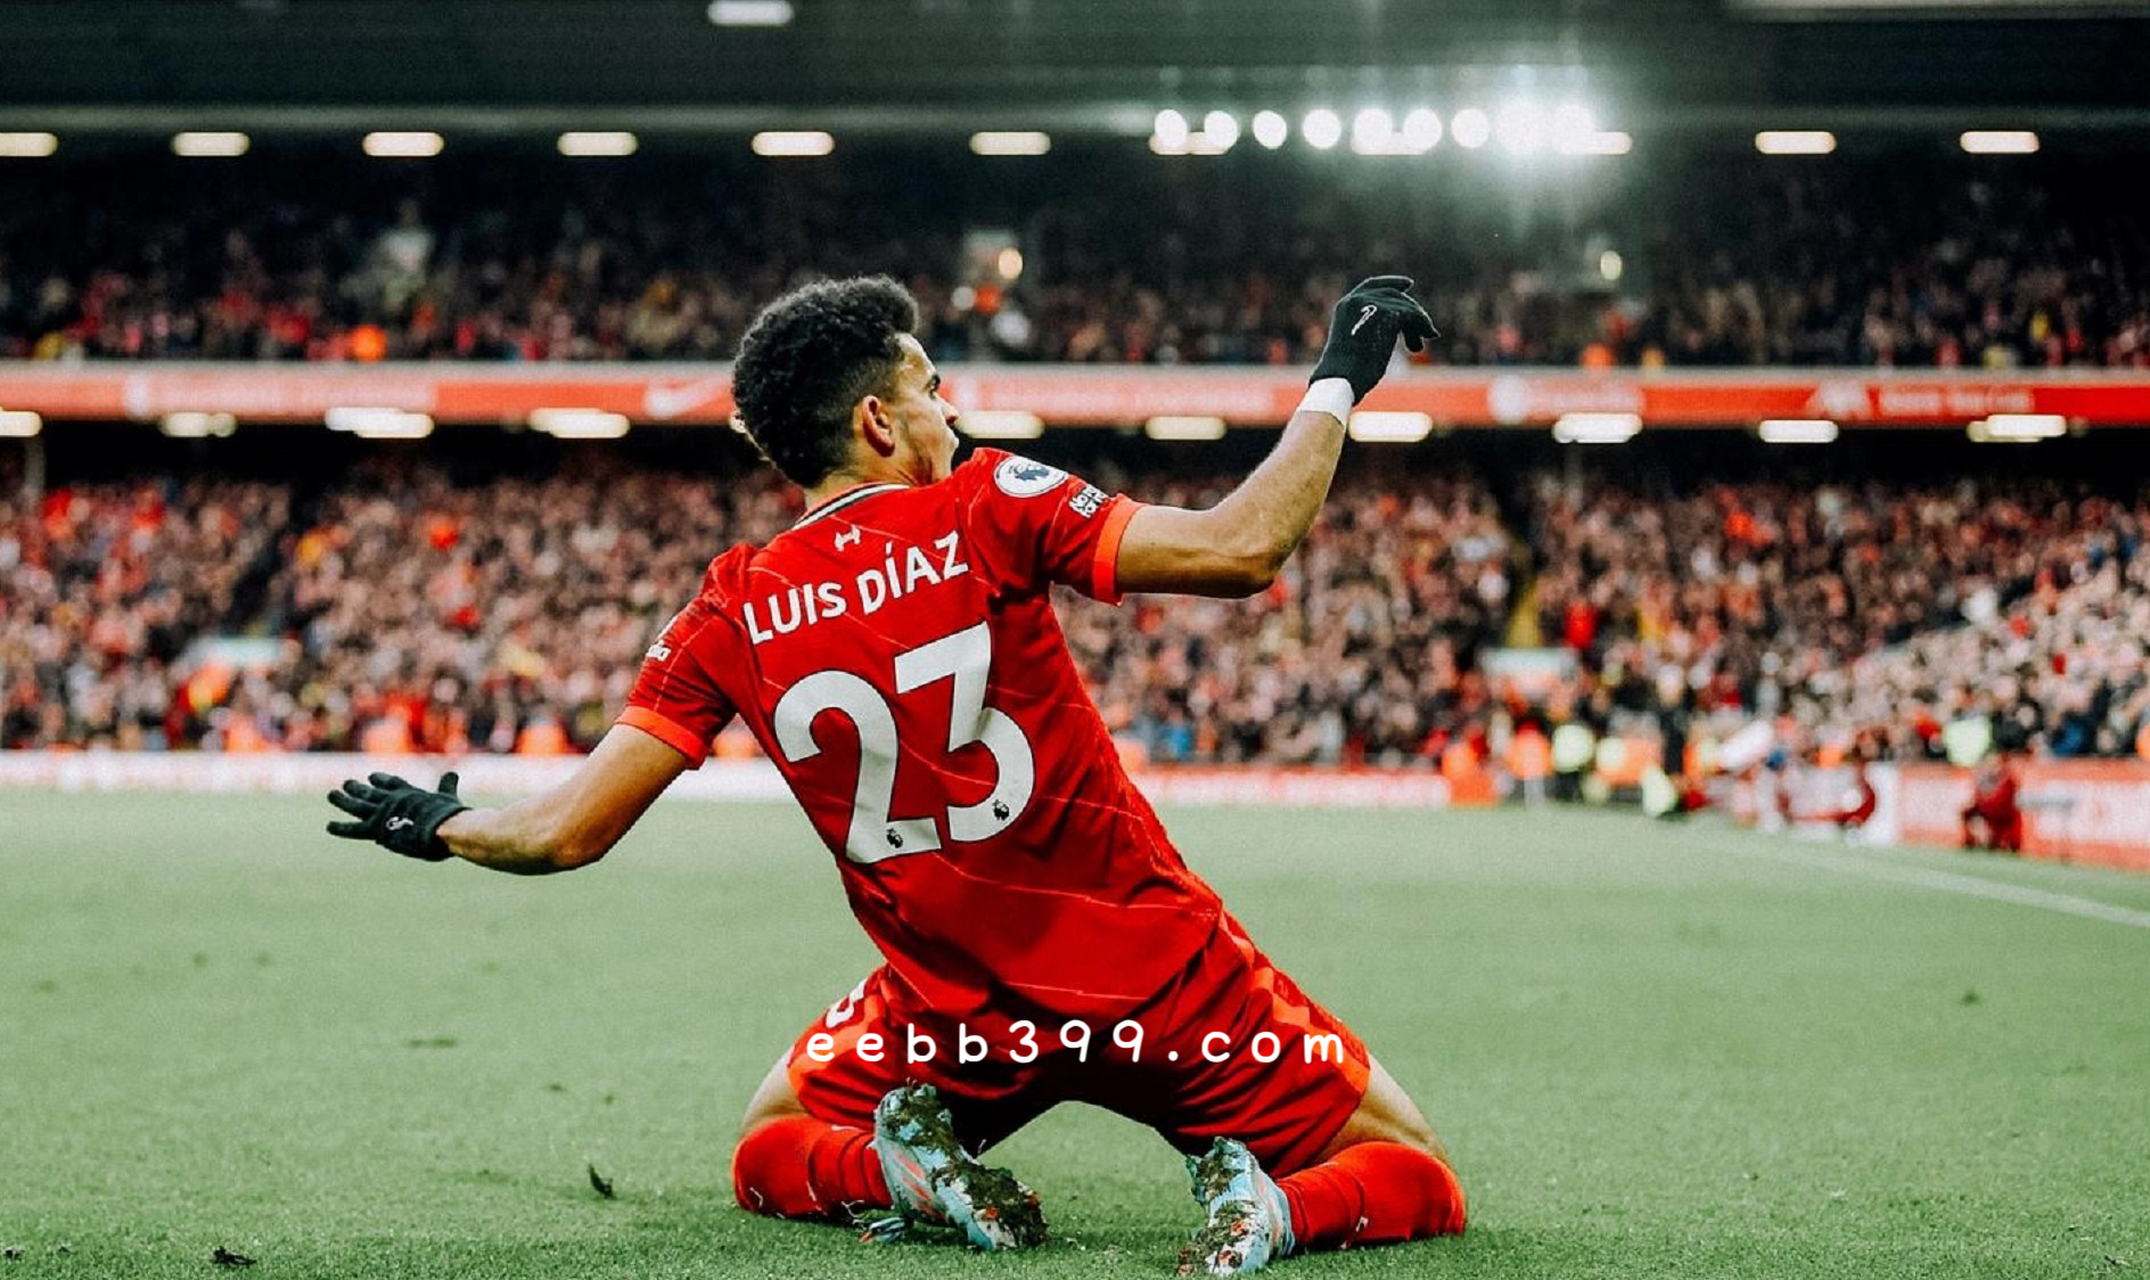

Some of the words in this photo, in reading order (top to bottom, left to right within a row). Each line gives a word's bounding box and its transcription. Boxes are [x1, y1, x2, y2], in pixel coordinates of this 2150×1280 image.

[743, 582, 847, 645] LUIS
[856, 530, 969, 616] DÍAZ
[773, 621, 1036, 865] 23
